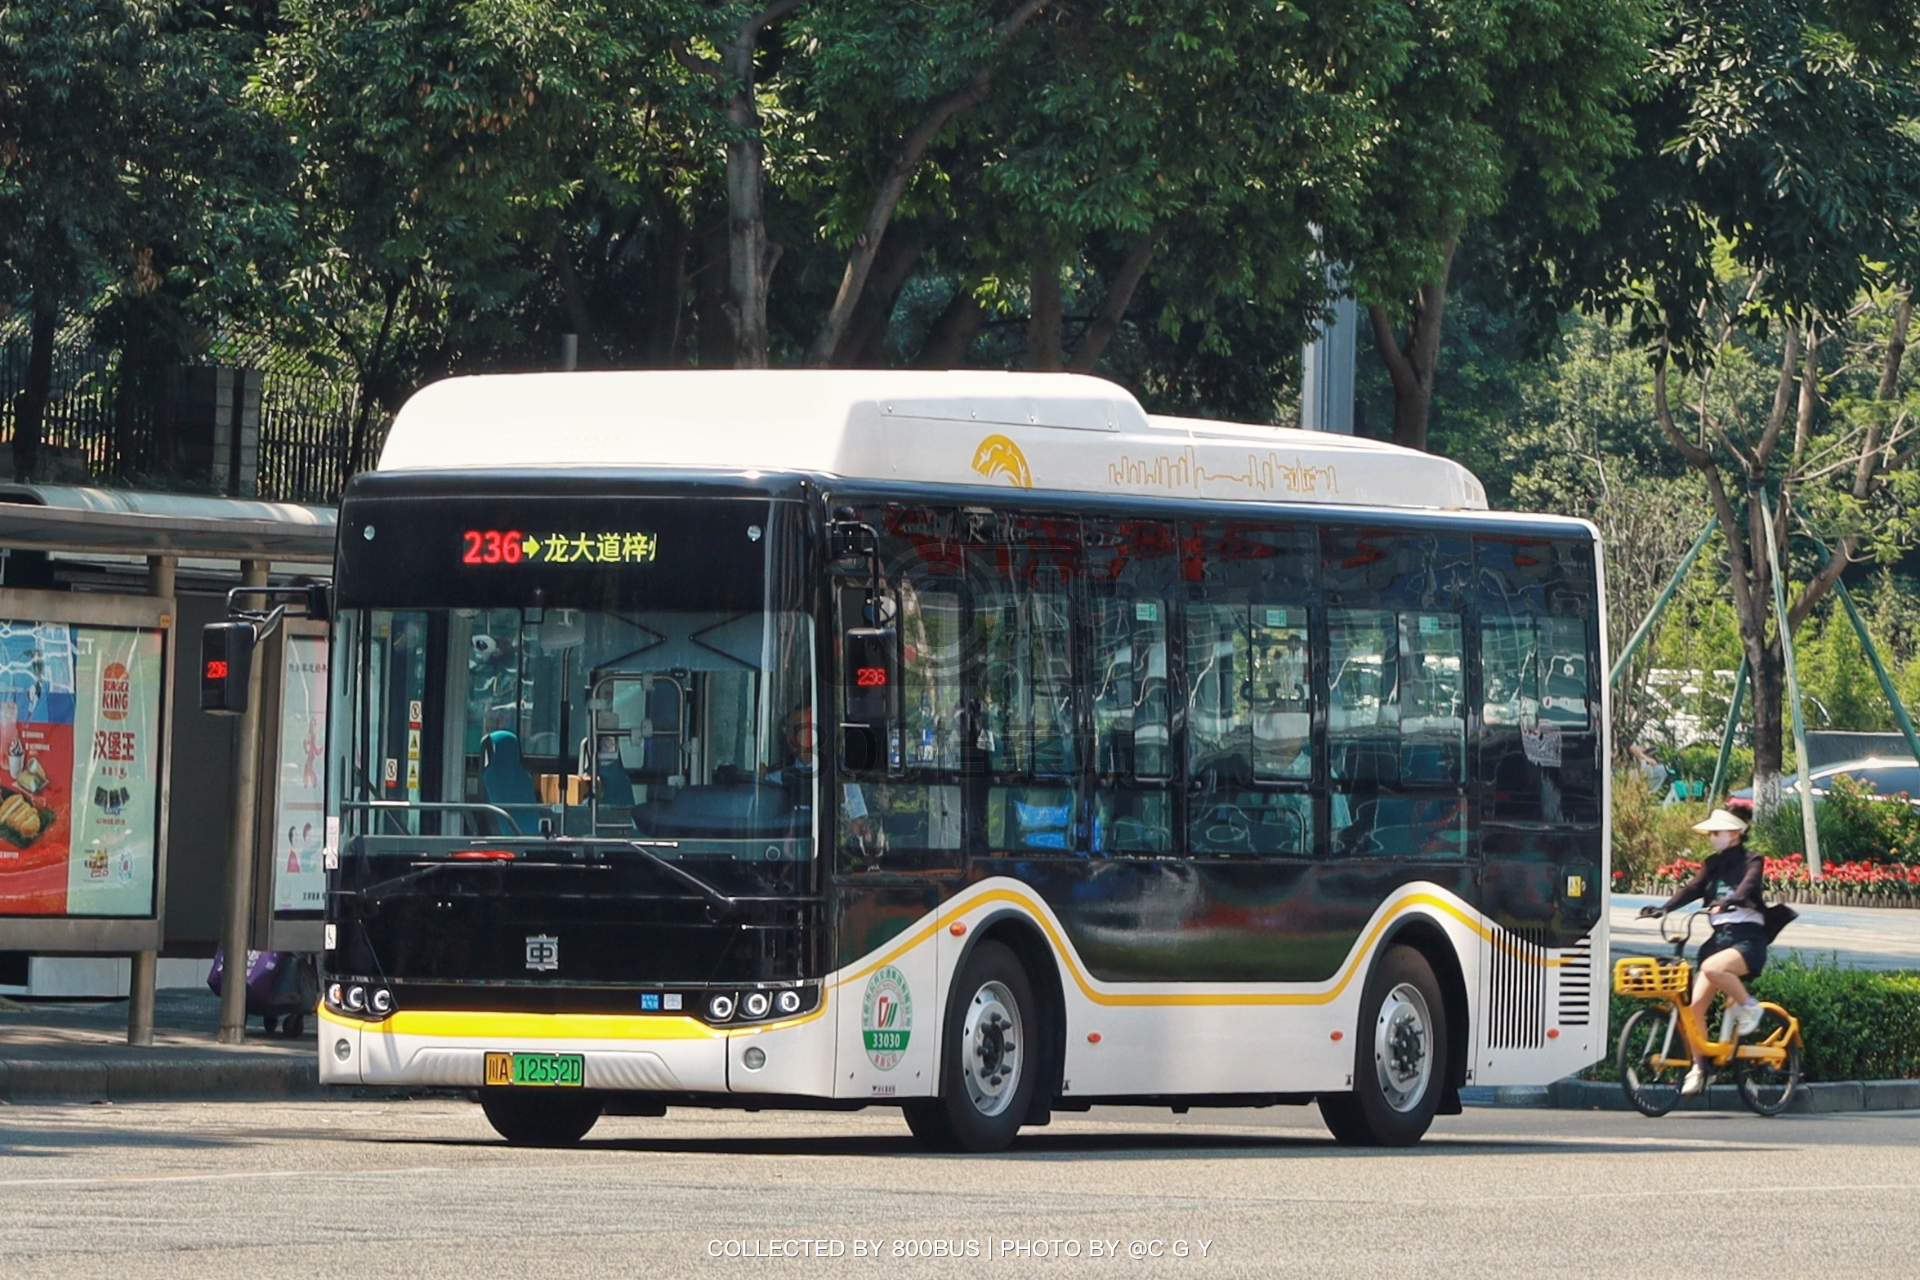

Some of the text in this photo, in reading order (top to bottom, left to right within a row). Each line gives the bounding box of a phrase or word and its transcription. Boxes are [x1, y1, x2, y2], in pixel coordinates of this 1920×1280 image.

[463, 529, 523, 564] 236
[206, 660, 228, 679] 236
[857, 668, 887, 686] 236
[103, 680, 129, 693] BURGER
[102, 693, 129, 710] KING
[93, 731, 136, 761] 汉堡王
[872, 1032, 901, 1049] 33030
[488, 1057, 581, 1082] 川A 12552D
